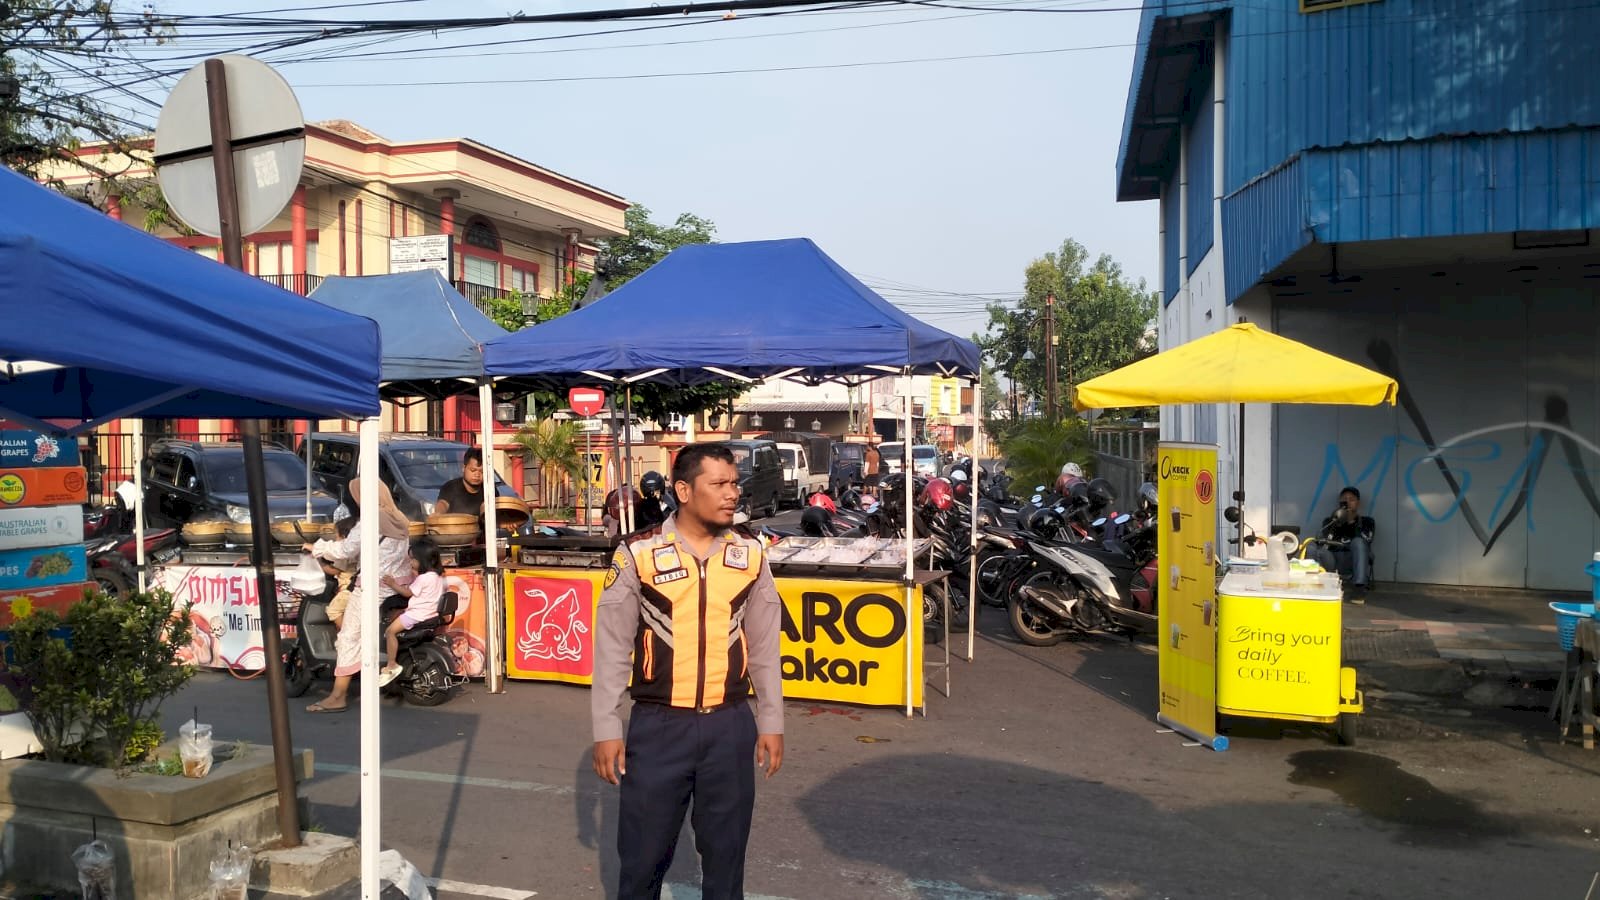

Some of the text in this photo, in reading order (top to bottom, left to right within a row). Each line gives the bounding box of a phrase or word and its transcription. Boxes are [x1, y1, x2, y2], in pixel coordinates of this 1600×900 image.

[1172, 466, 1190, 475] KECIK
[1200, 480, 1211, 498] 10
[0, 519, 46, 529] AUSTRALIAN
[20, 527, 48, 535] GRAPES
[188, 574, 283, 607] DIMSU
[1228, 625, 1332, 647] Bring your
[1237, 647, 1282, 665] daily
[1237, 666, 1311, 684] COFFEE.
